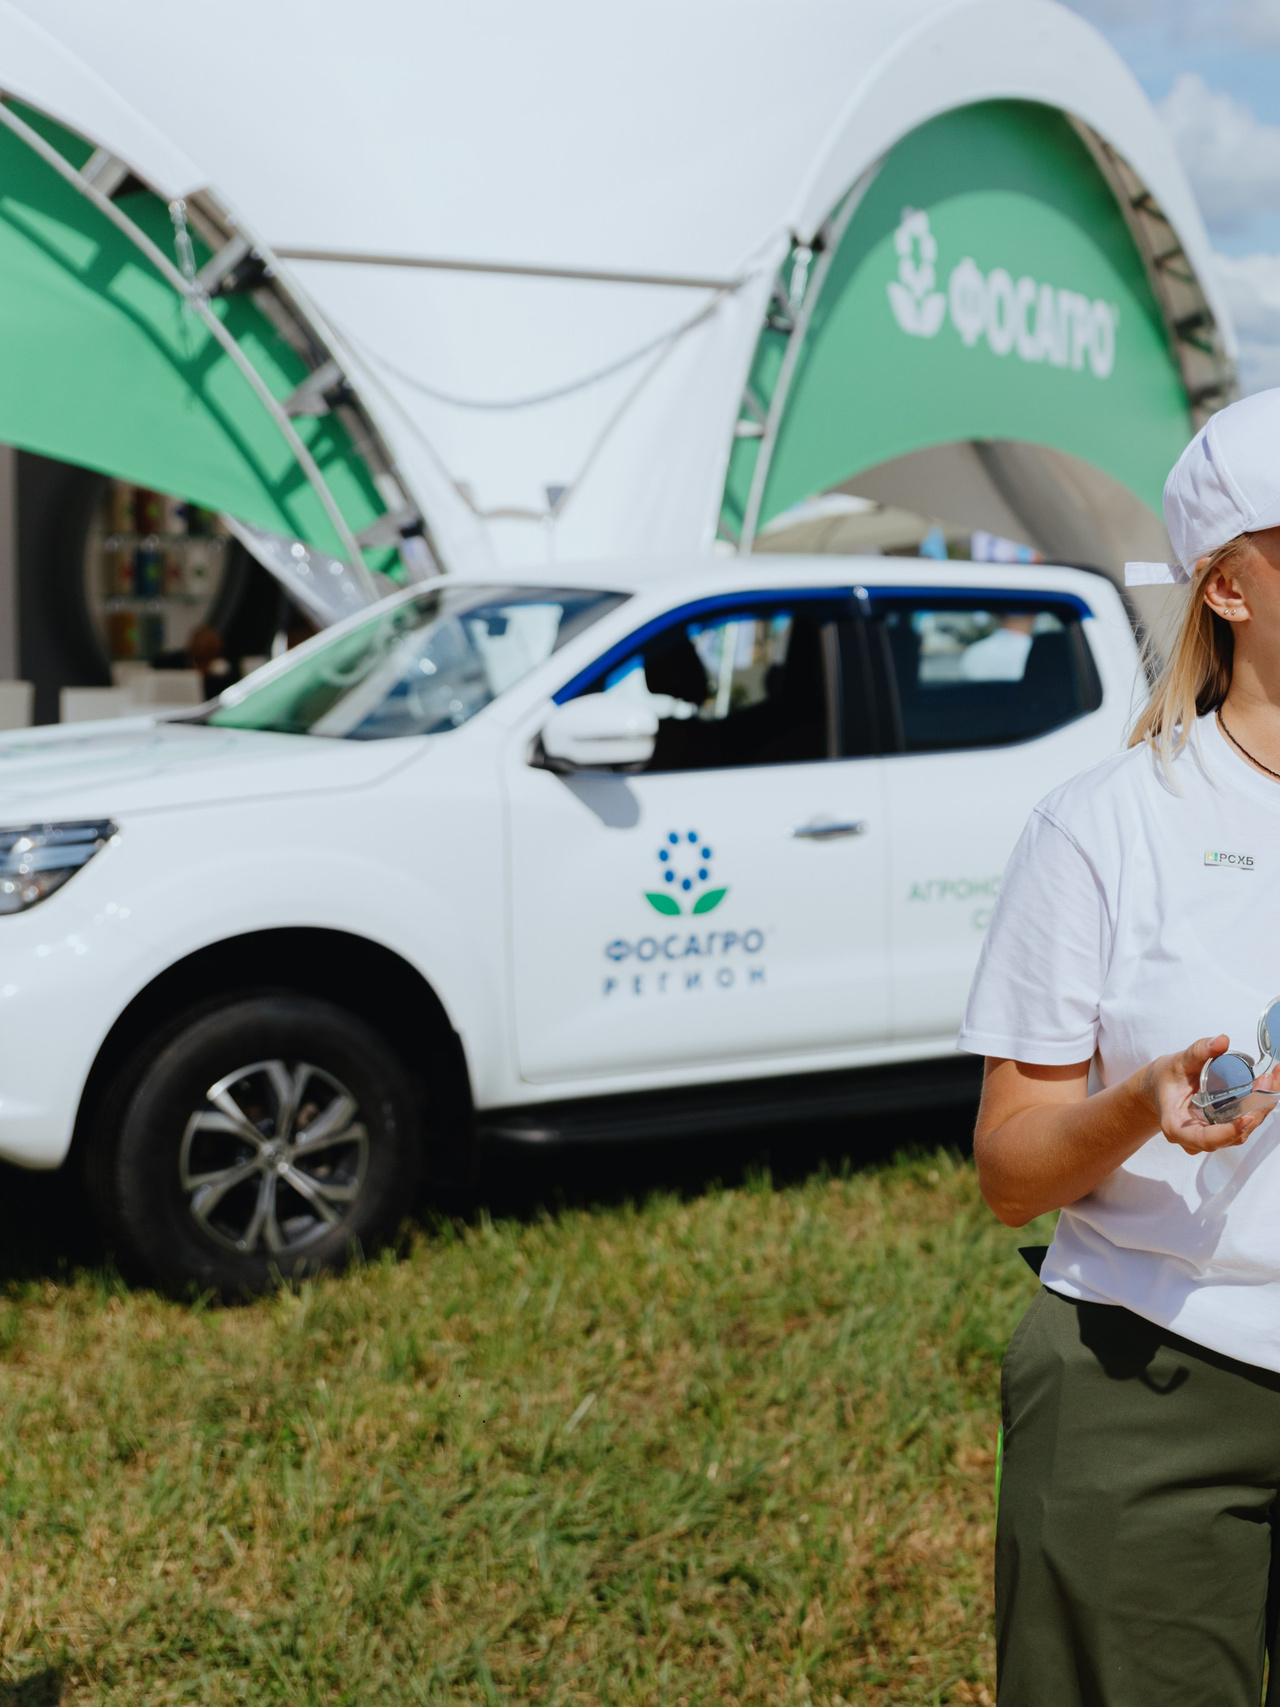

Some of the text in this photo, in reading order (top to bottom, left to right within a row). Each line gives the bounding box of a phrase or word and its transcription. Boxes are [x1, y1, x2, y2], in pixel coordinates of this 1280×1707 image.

[949, 256, 1116, 379] ФОСАГРО
[1219, 853, 1254, 866] РСХБ
[605, 928, 765, 963] ФОСАГРО
[603, 965, 765, 997] РЕГИОН
